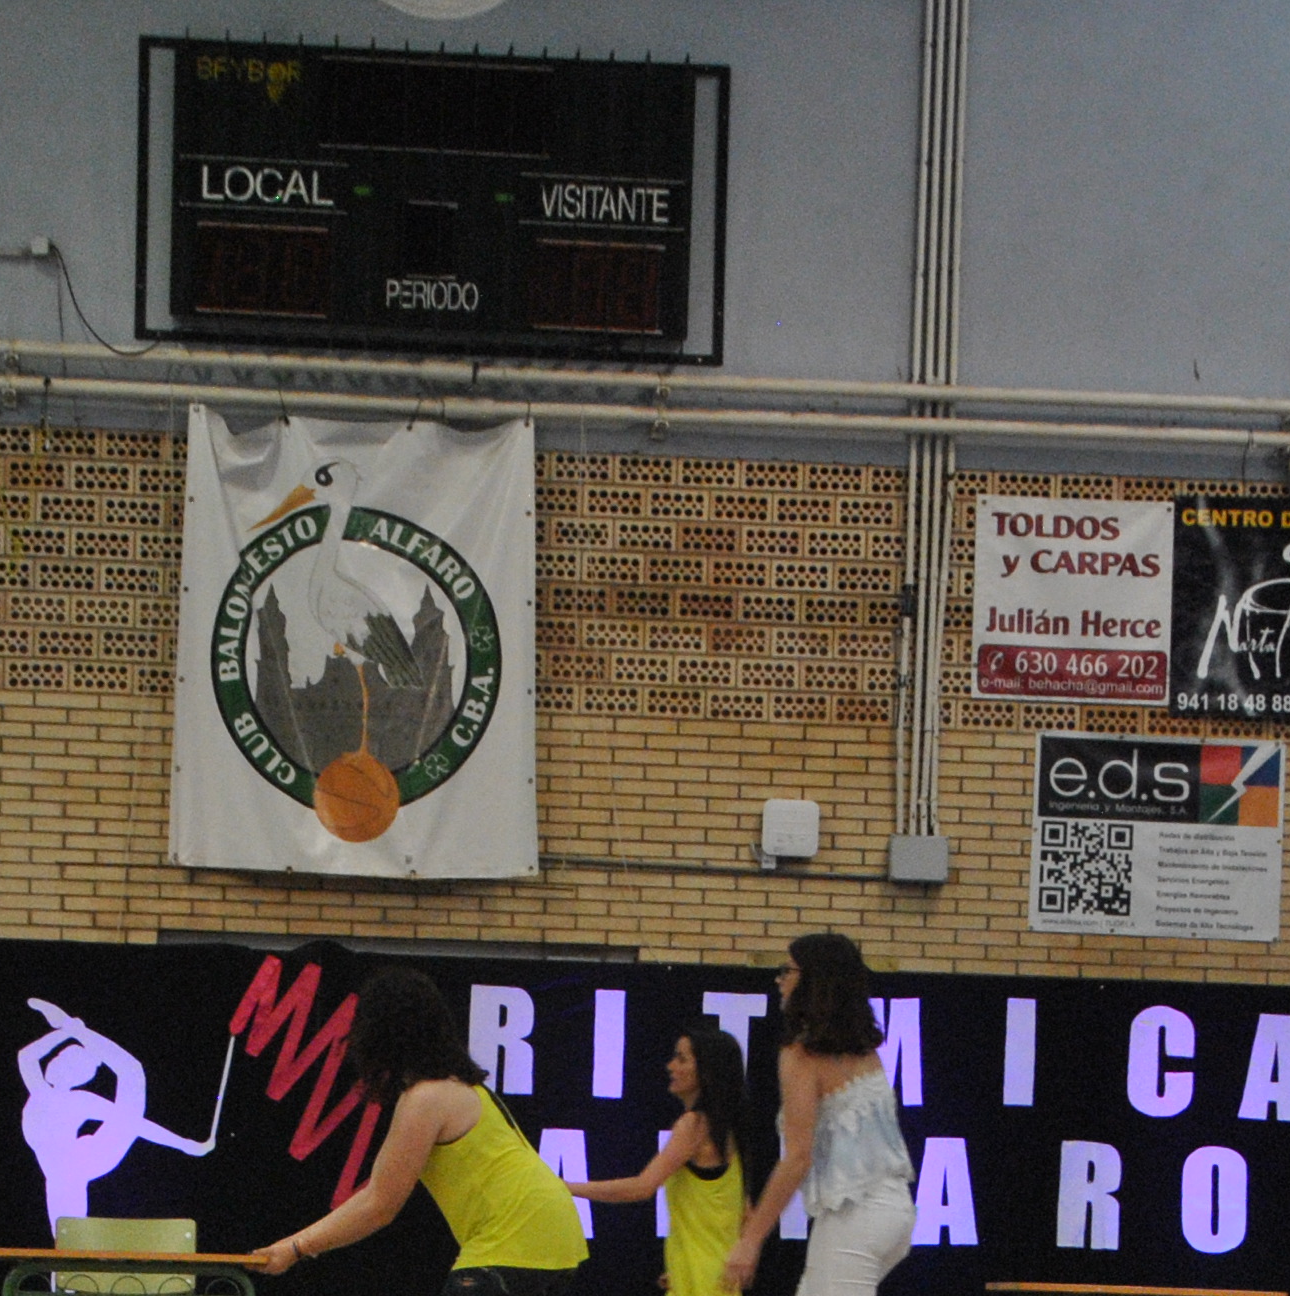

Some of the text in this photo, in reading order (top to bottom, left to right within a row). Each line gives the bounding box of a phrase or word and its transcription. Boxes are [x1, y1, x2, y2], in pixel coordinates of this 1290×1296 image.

[201, 164, 334, 207] LOCAL
[540, 184, 670, 224] VISITANTE
[385, 278, 479, 311] PERIODO
[992, 512, 1121, 541] TOLDOS
[1181, 508, 1273, 529] CENTRO
[1001, 549, 1161, 578] y CARPAS
[986, 606, 1162, 639] Julián Herce
[234, 712, 297, 785] CLUB
[369, 518, 477, 601] ALFARO
[451, 667, 495, 748] C.B.A.
[1014, 651, 1158, 679] 630 466 202
[980, 677, 1164, 695] e-mail: behacha@gmail.com
[1177, 693, 1209, 711] 941
[1217, 693, 1239, 711] 18
[1244, 694, 1266, 712] 48
[1049, 747, 1190, 802] e.d.s
[537, 1127, 1248, 1254] AARO
